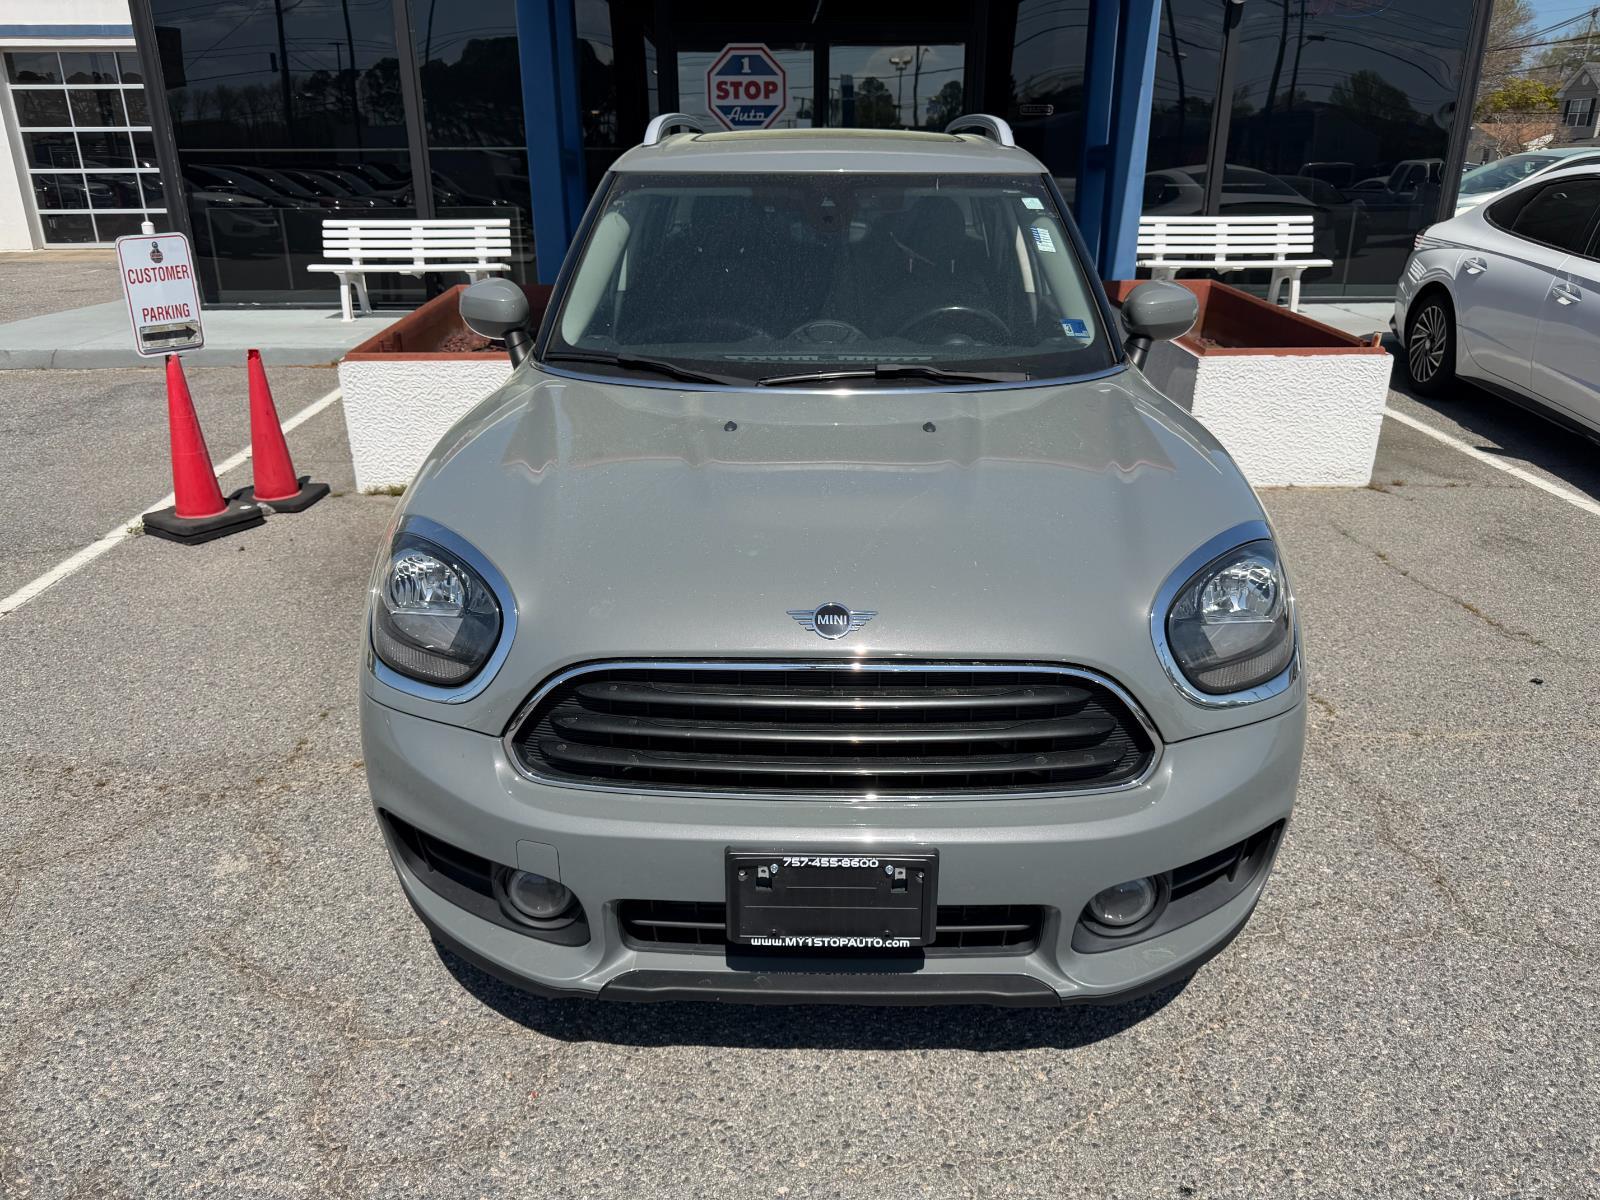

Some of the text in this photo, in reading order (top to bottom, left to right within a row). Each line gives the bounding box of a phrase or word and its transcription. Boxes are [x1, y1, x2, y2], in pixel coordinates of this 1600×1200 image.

[741, 57, 752, 73] 1
[716, 81, 778, 100] STOP
[727, 107, 766, 121] Auto
[127, 264, 190, 285] CUSTOMER
[142, 303, 191, 322] PARKING
[817, 614, 848, 625] MINI
[751, 937, 910, 948] www.MY1STOPAUTO.com
